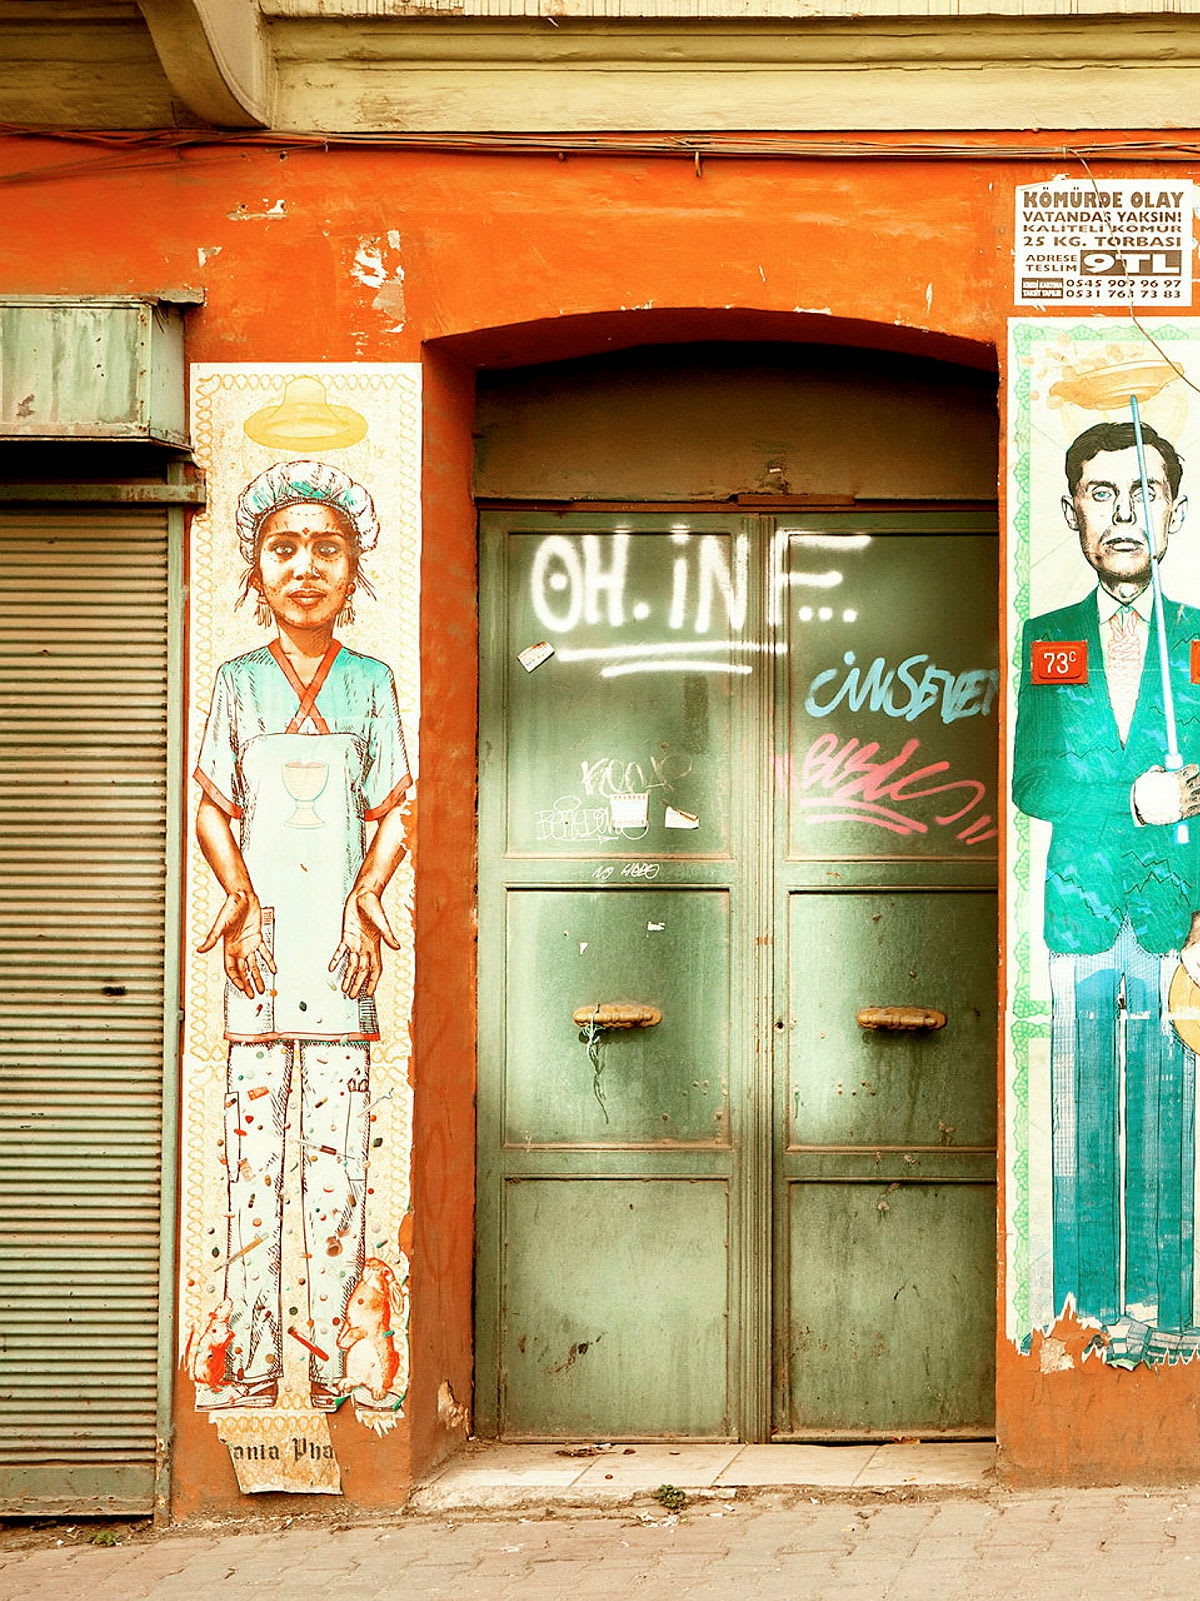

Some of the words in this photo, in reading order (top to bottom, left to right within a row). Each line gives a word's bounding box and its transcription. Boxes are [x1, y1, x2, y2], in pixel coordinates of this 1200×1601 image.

[1023, 186, 1123, 209] KÖMÜRDE
[1130, 191, 1184, 209] OLAY
[1117, 211, 1182, 223] YAKSIN!
[1023, 236, 1046, 247] 25
[1054, 236, 1088, 247] KG.
[1095, 236, 1182, 247] TORBASI
[1025, 254, 1078, 262] ADRESE
[1083, 253, 1181, 274] 9TL
[1066, 279, 1102, 288] 0545
[1108, 279, 1136, 288] 909
[1141, 279, 1159, 288] 96
[1164, 279, 1182, 288] 97
[1066, 289, 1101, 299] 0531
[1108, 289, 1135, 299] 763
[1140, 289, 1158, 299] 73
[1164, 289, 1181, 299] 83
[232, 1442, 280, 1461] anta
